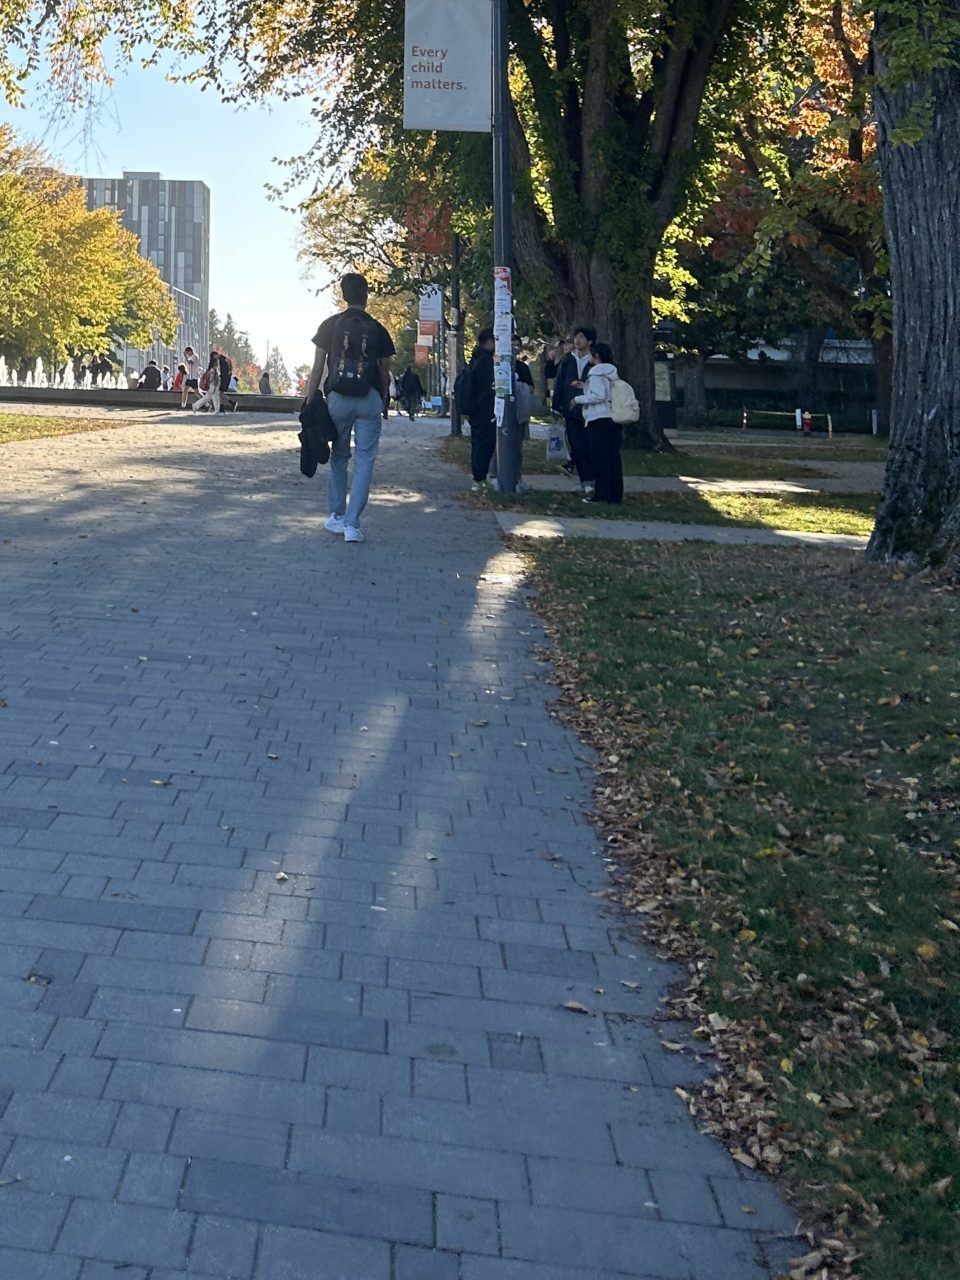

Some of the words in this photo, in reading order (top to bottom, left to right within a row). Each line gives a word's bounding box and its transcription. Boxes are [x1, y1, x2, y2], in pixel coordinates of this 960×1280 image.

[411, 45, 448, 60] Every
[411, 61, 443, 73] child
[411, 79, 467, 90] matters.
